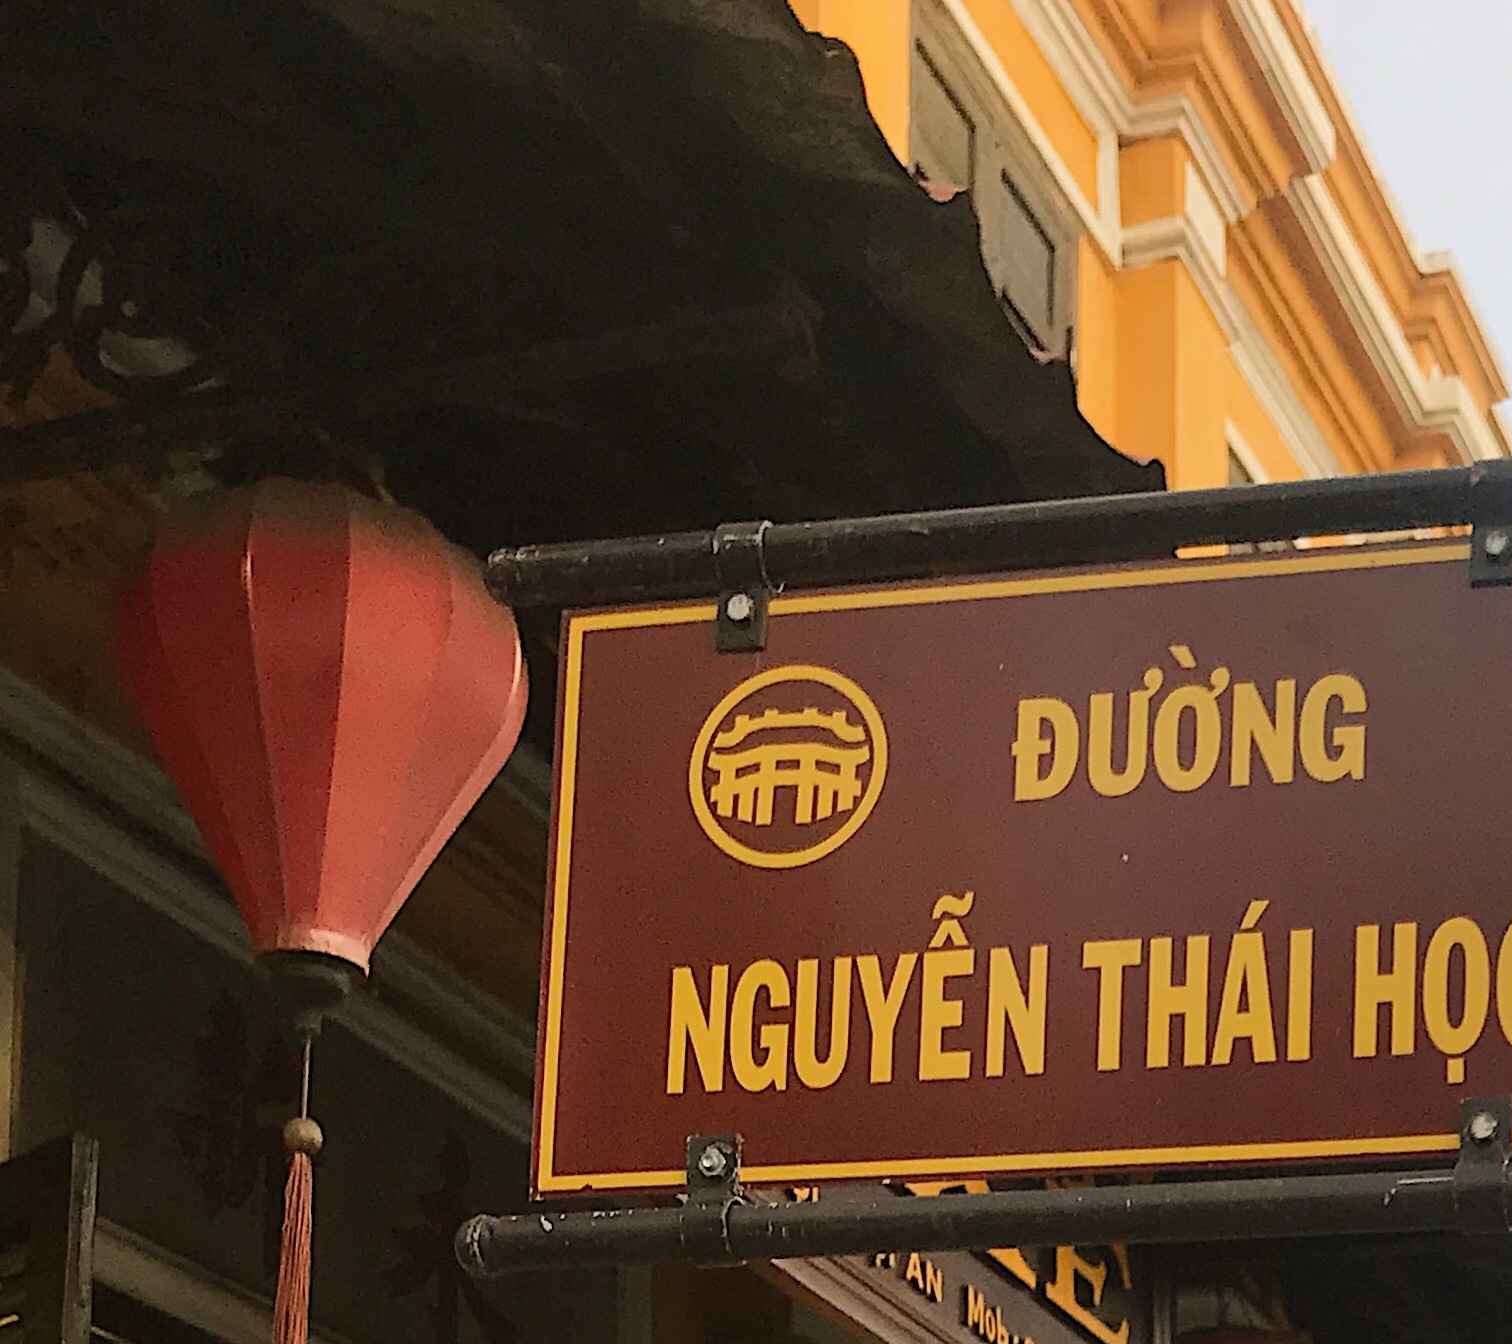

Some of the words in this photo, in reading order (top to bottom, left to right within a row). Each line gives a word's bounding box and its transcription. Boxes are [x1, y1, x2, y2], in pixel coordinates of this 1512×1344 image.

[1012, 645, 1368, 804] ĐƯỜNG
[666, 890, 1049, 1094] NGUYỄN
[1082, 899, 1314, 1071] THÁI
